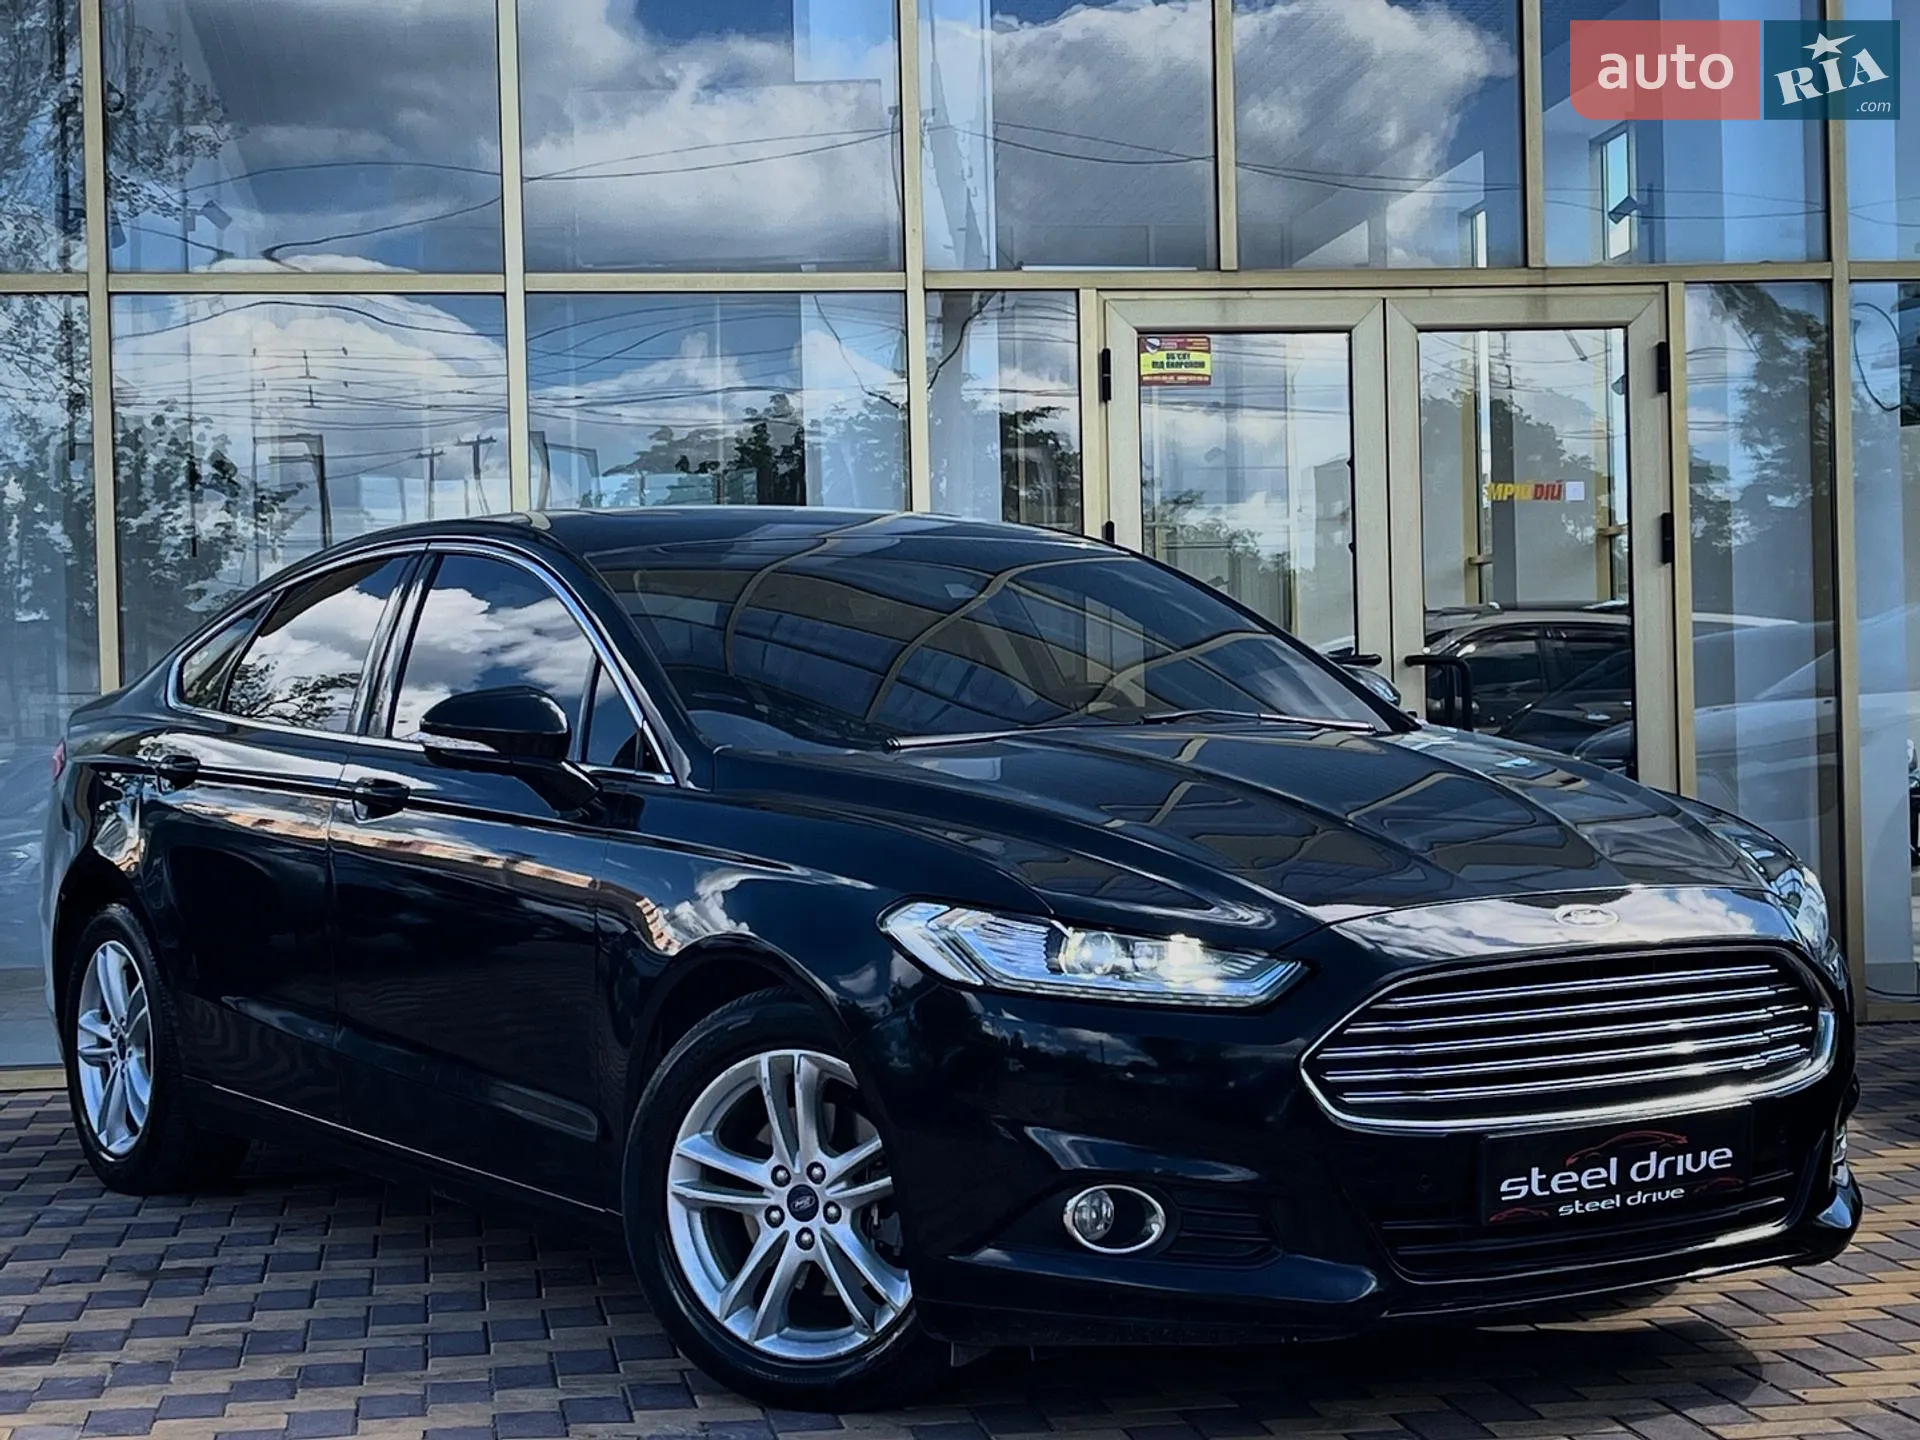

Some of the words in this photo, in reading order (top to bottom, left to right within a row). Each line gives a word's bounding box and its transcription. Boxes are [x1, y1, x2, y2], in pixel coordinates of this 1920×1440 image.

[1500, 1157, 1618, 1201] steel
[1629, 1147, 1733, 1183] drive
[1558, 1194, 1621, 1217] steel
[1626, 1187, 1686, 1207] drive
